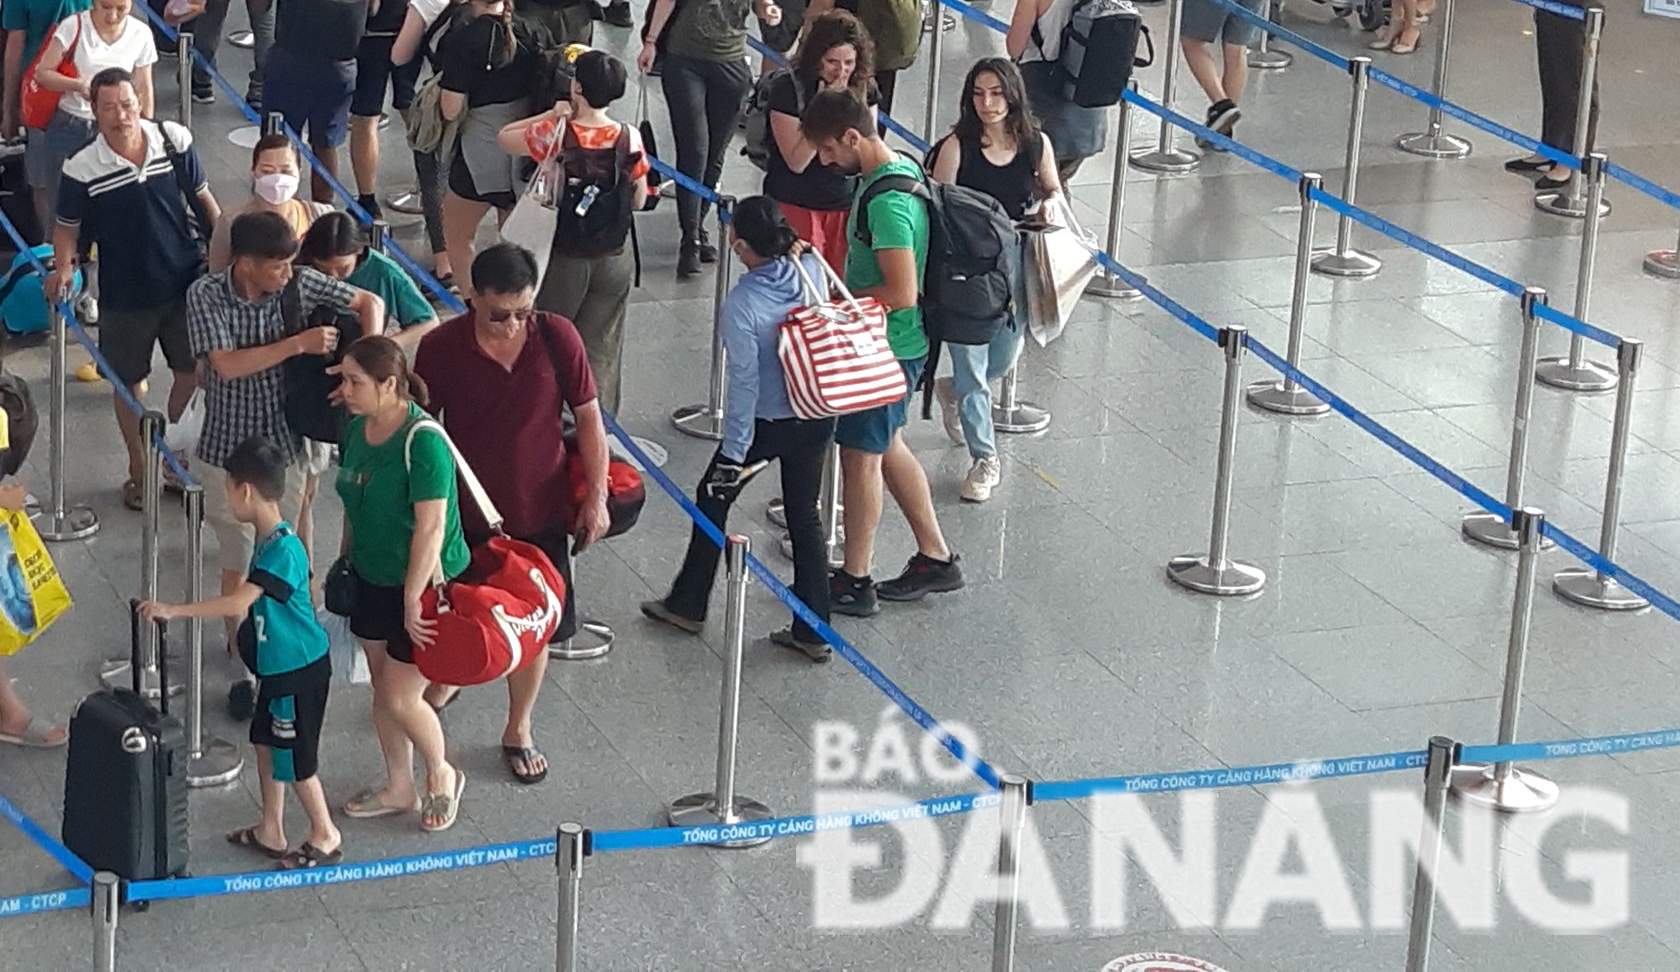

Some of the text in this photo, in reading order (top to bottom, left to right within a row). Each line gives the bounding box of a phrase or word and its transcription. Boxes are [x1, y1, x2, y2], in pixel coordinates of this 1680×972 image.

[1199, 773, 1215, 785] TY
[1366, 757, 1396, 770] NAM
[682, 824, 718, 842] TỔNG
[720, 822, 757, 839] CÔNG
[760, 822, 776, 835] TY
[777, 816, 814, 834] CẢNG
[816, 811, 853, 829] HÀNG
[855, 804, 900, 825] KHÔNG
[902, 801, 930, 818] VIỆT
[931, 800, 962, 813] NAM
[223, 872, 262, 892] TỔNG
[264, 870, 303, 889] CÔNG
[305, 871, 322, 884] TY
[324, 863, 363, 883] CẢNG
[365, 860, 404, 879] HÀNG
[406, 854, 453, 875] KHÔNG
[455, 849, 485, 867] VIỆT
[486, 846, 519, 862] NAM
[31, 893, 67, 910] CTCP
